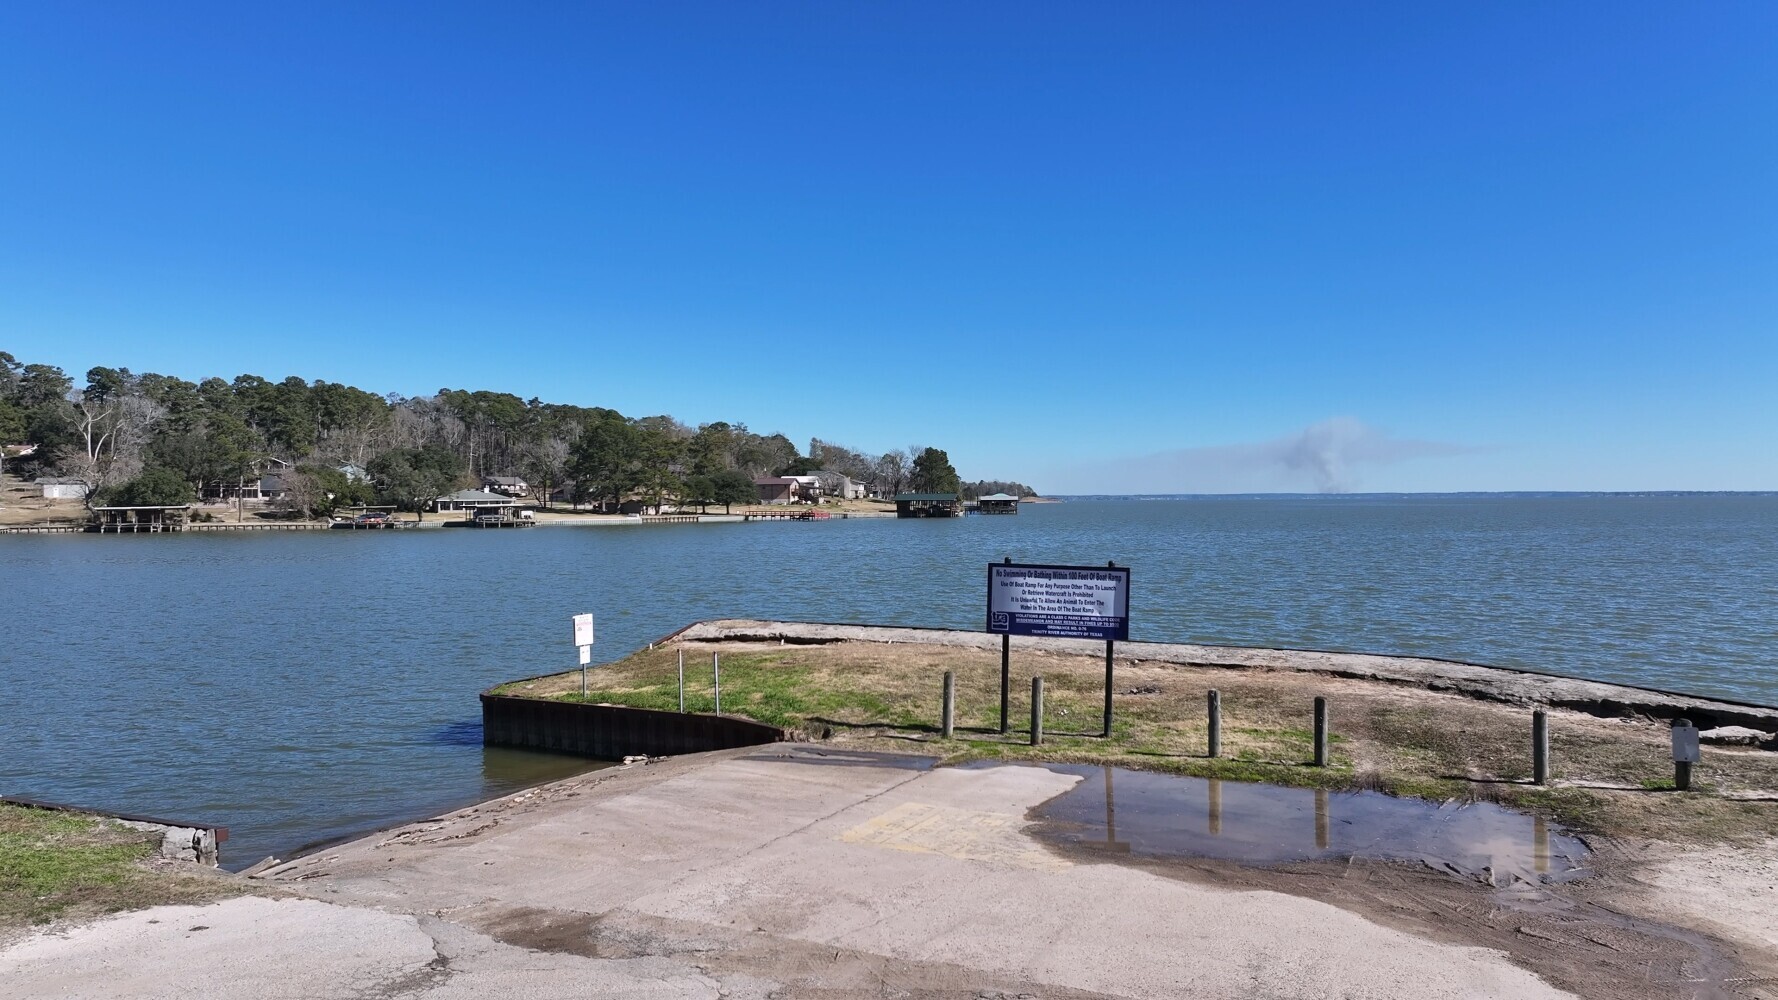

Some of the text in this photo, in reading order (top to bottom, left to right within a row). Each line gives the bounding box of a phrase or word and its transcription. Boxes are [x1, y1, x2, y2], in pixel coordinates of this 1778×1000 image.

[1003, 570, 1026, 580] Swimming
[1034, 570, 1051, 580] Bathing
[1053, 571, 1067, 579] Within
[1108, 573, 1121, 584] Ramp
